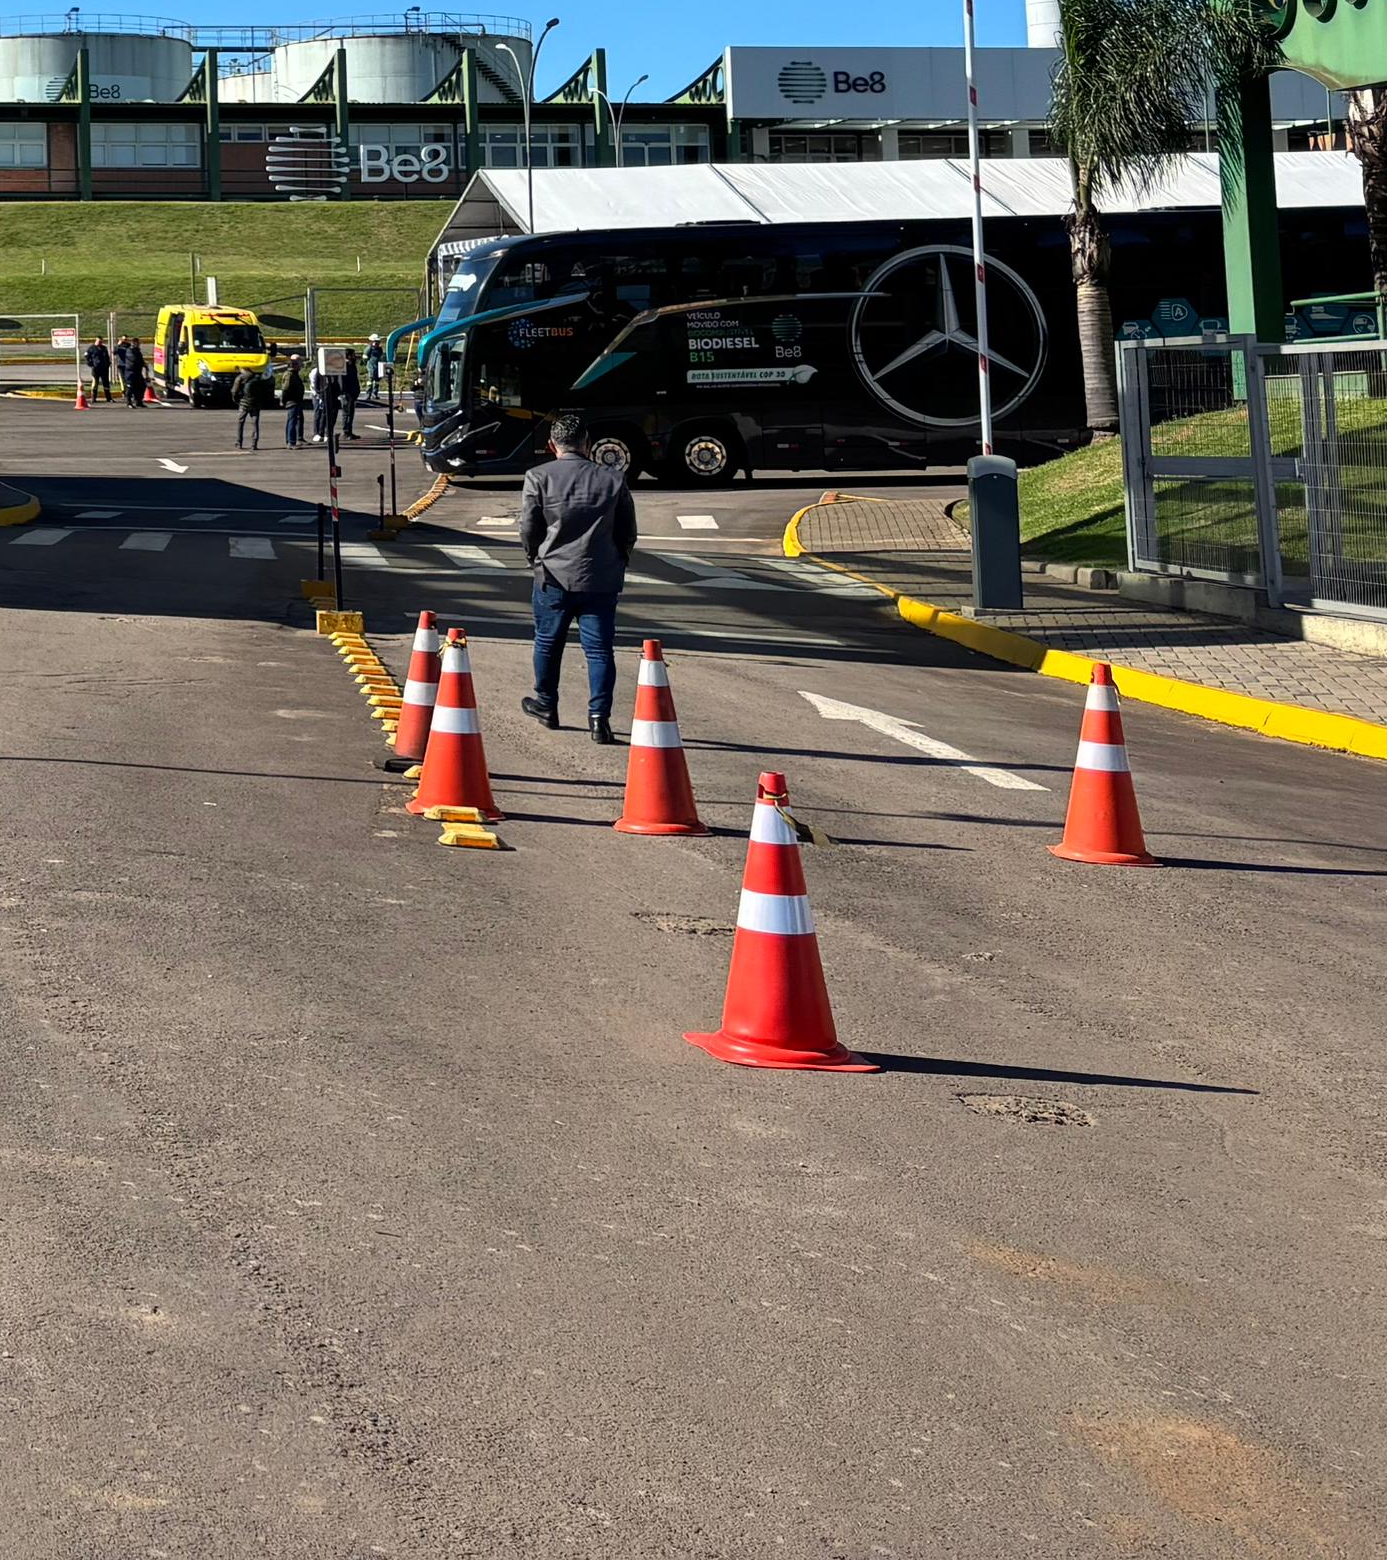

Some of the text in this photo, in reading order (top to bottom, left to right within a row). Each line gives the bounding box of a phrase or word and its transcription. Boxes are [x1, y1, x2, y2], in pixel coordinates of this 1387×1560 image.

[833, 70, 886, 93] Be8
[88, 83, 121, 99] Be8
[359, 144, 449, 183] Be8
[687, 320, 739, 329] MOVIDO COM
[519, 327, 574, 337] FLEETBUS
[688, 337, 760, 350] BIODIESEL
[690, 351, 715, 363] B15
[775, 345, 802, 358] Be8
